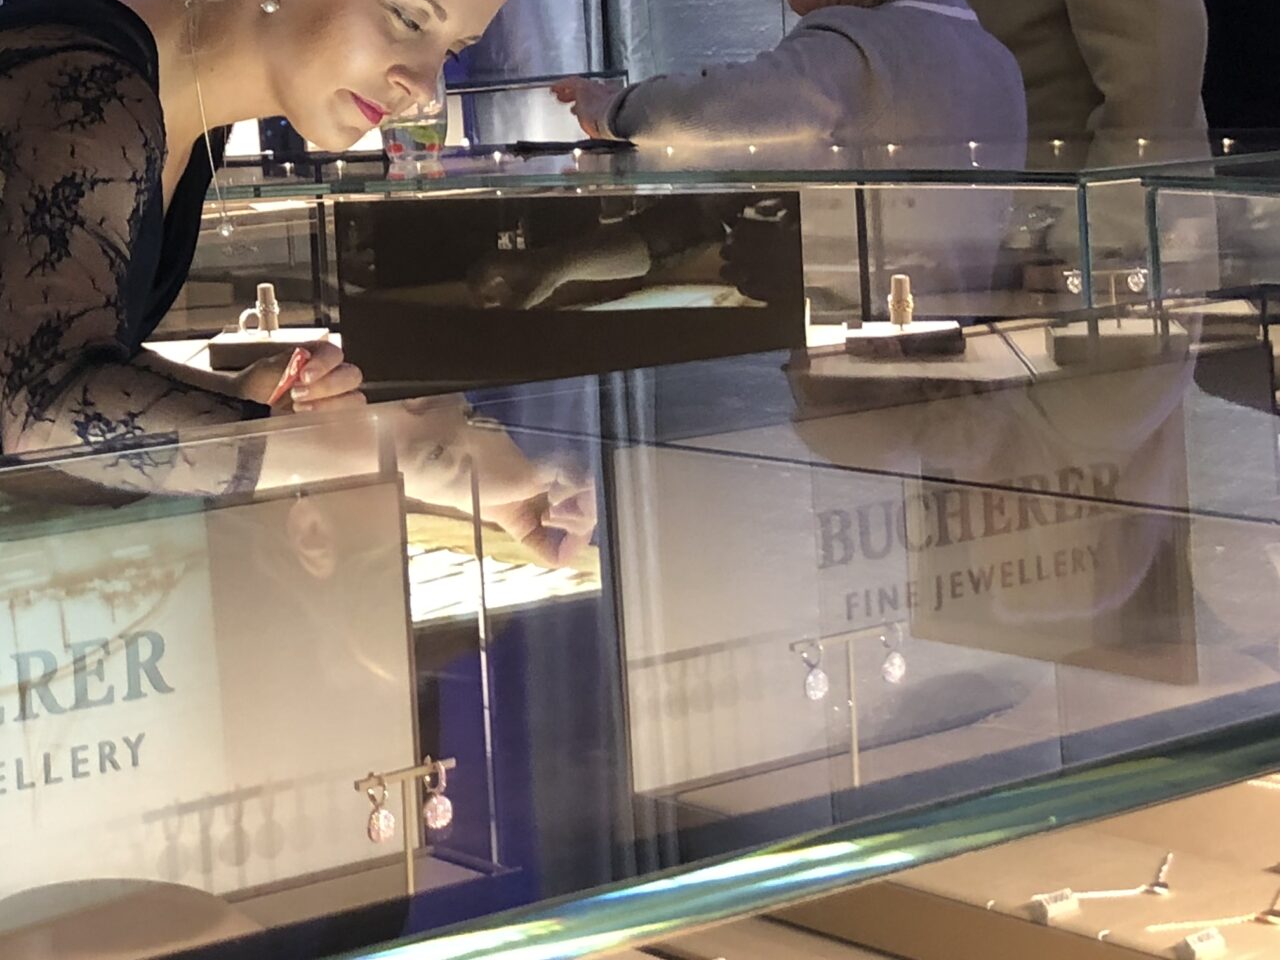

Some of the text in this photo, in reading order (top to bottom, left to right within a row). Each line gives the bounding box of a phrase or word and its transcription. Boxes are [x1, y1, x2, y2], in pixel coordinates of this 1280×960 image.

[816, 462, 1120, 569] BUCHERER
[846, 545, 1101, 621] FINE JEWELLERY
